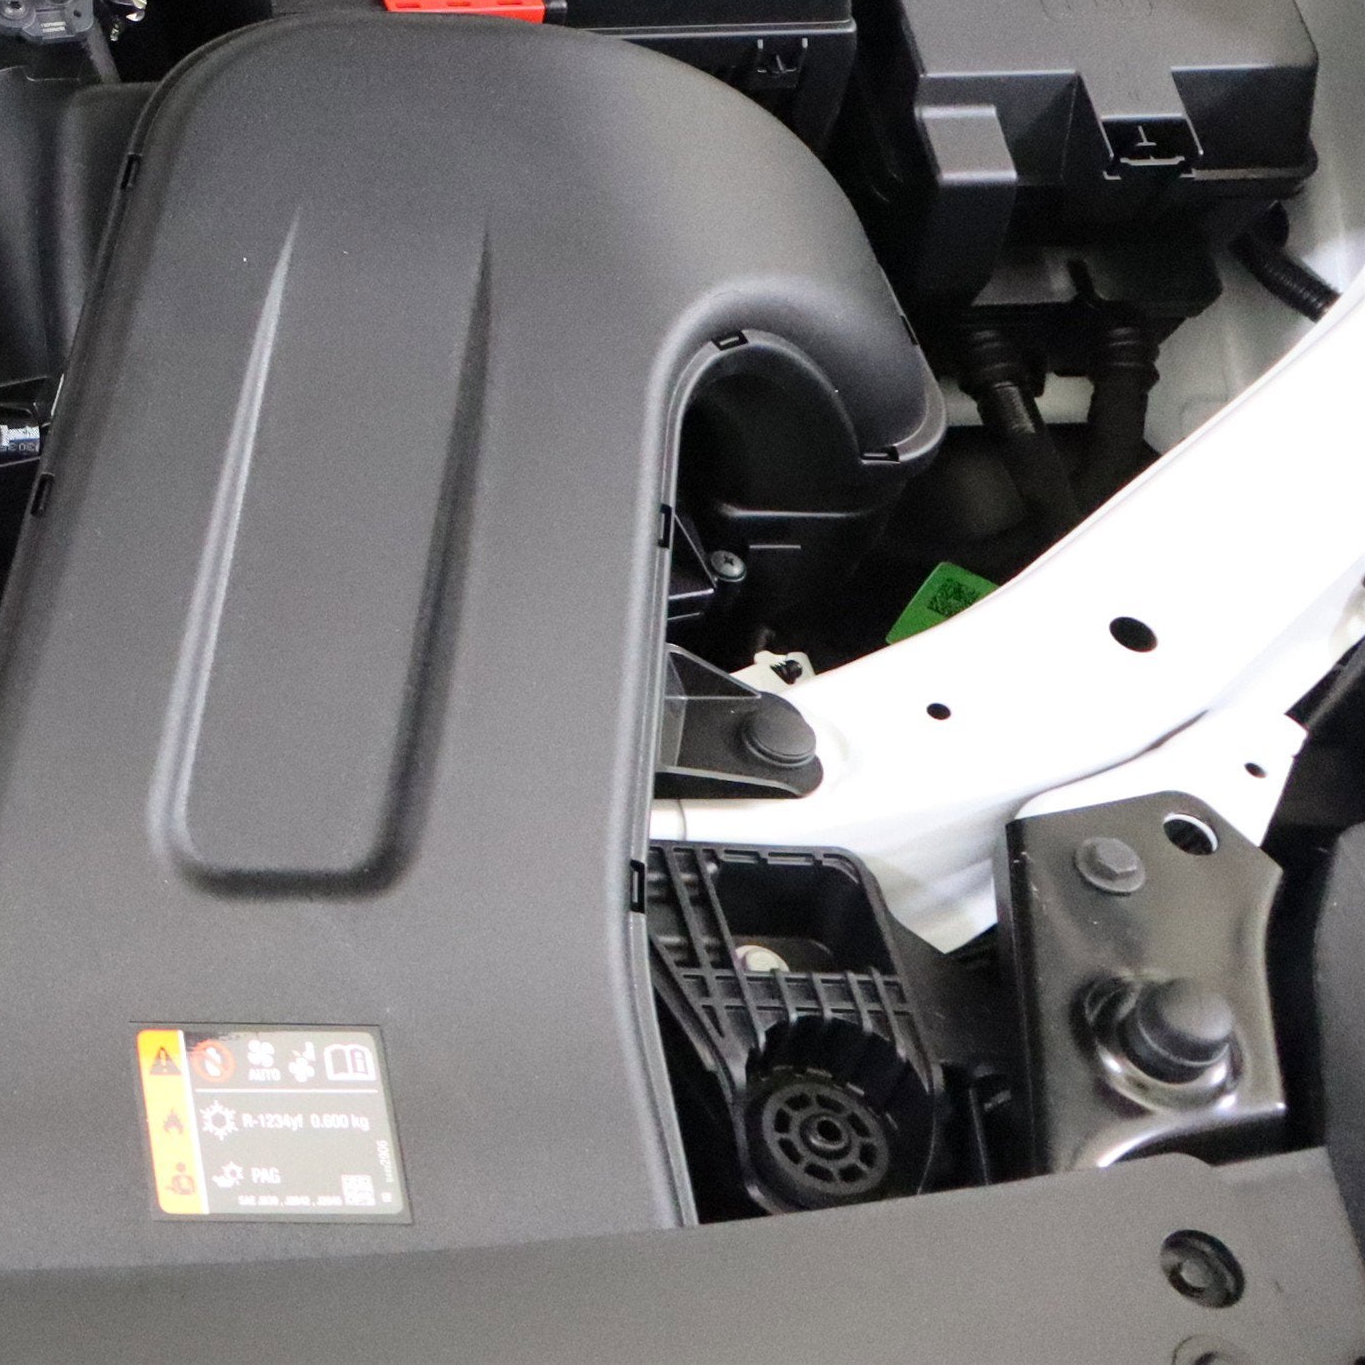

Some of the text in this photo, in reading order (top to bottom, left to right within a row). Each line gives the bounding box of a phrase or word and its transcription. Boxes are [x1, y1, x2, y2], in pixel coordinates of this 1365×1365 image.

[248, 1068, 281, 1081] AUTO
[242, 1113, 303, 1132] R-1234yf
[351, 1113, 370, 1132] kg
[251, 1167, 281, 1184] PAG
